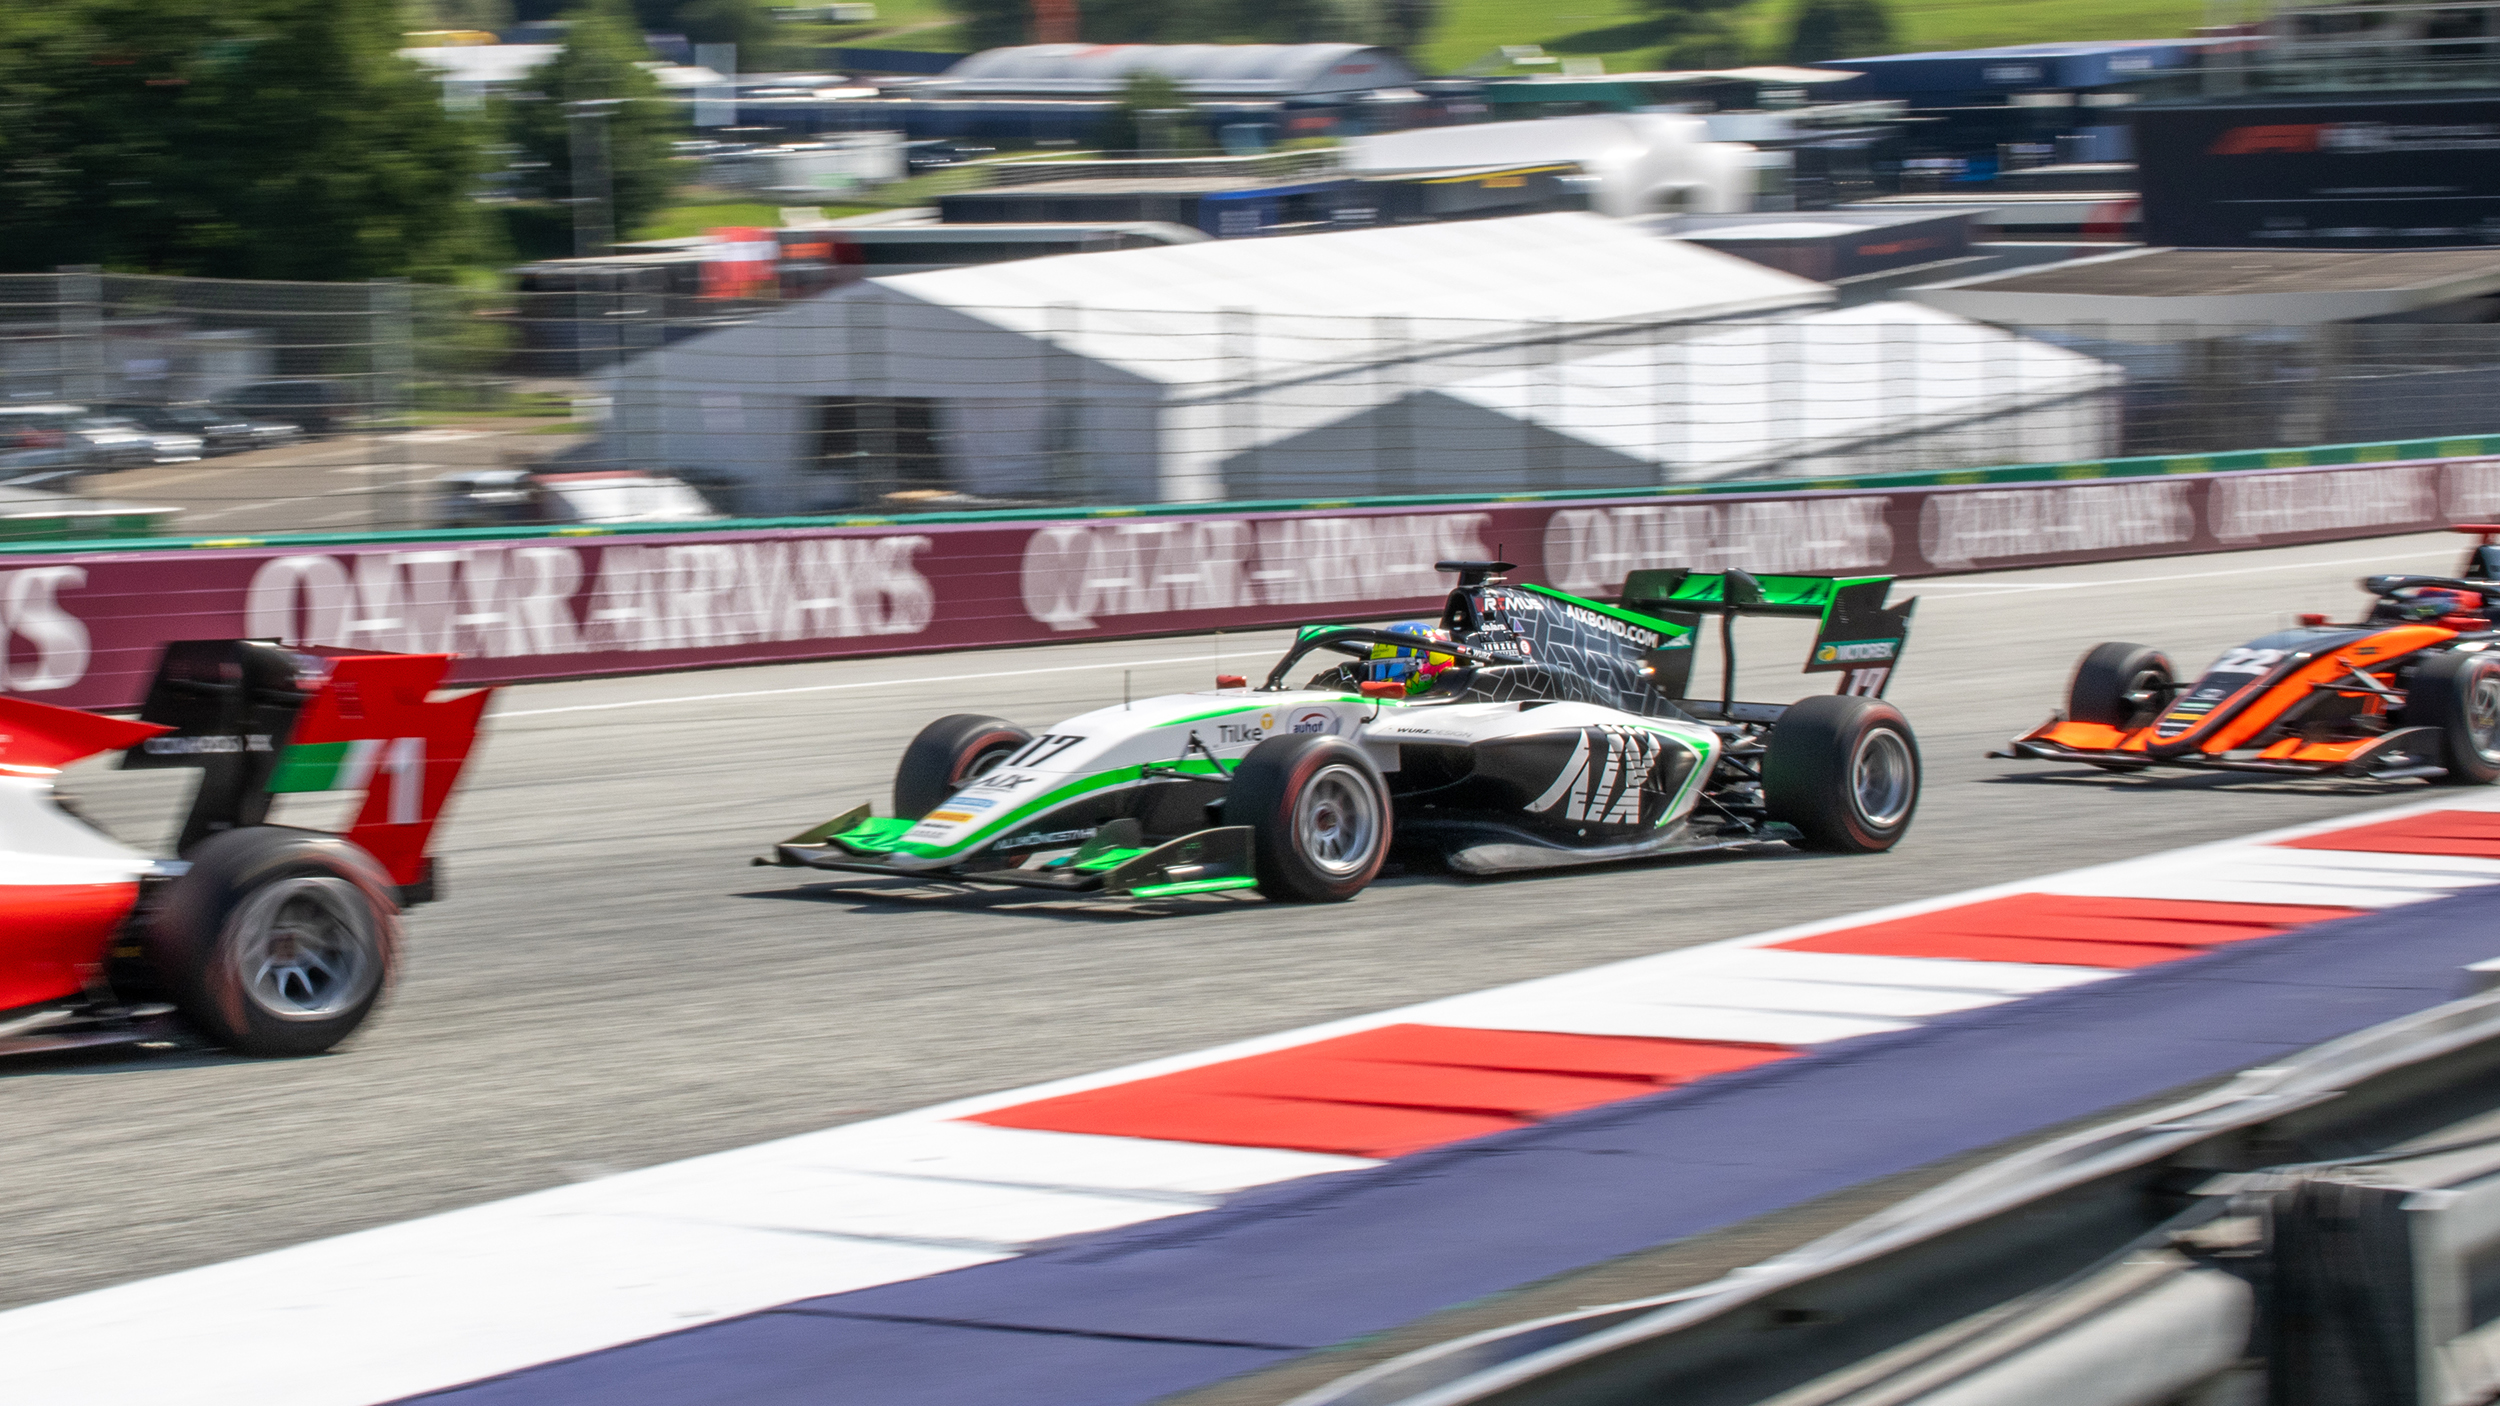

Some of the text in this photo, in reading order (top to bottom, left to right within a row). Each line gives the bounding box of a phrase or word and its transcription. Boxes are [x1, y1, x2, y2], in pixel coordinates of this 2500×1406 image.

[1020, 511, 1493, 631] QATAR AIRWAYS
[246, 535, 936, 658] QATAR AIRWAYS
[1483, 597, 1545, 612] REMUS
[1565, 604, 1660, 649] AIXBOND.COM
[1473, 648, 1493, 660] WURZ
[2210, 647, 2286, 676] 22
[1846, 667, 1891, 698] 17
[1217, 724, 1264, 743] Tilke
[1008, 734, 1090, 767] 17
[379, 736, 427, 824] 1
